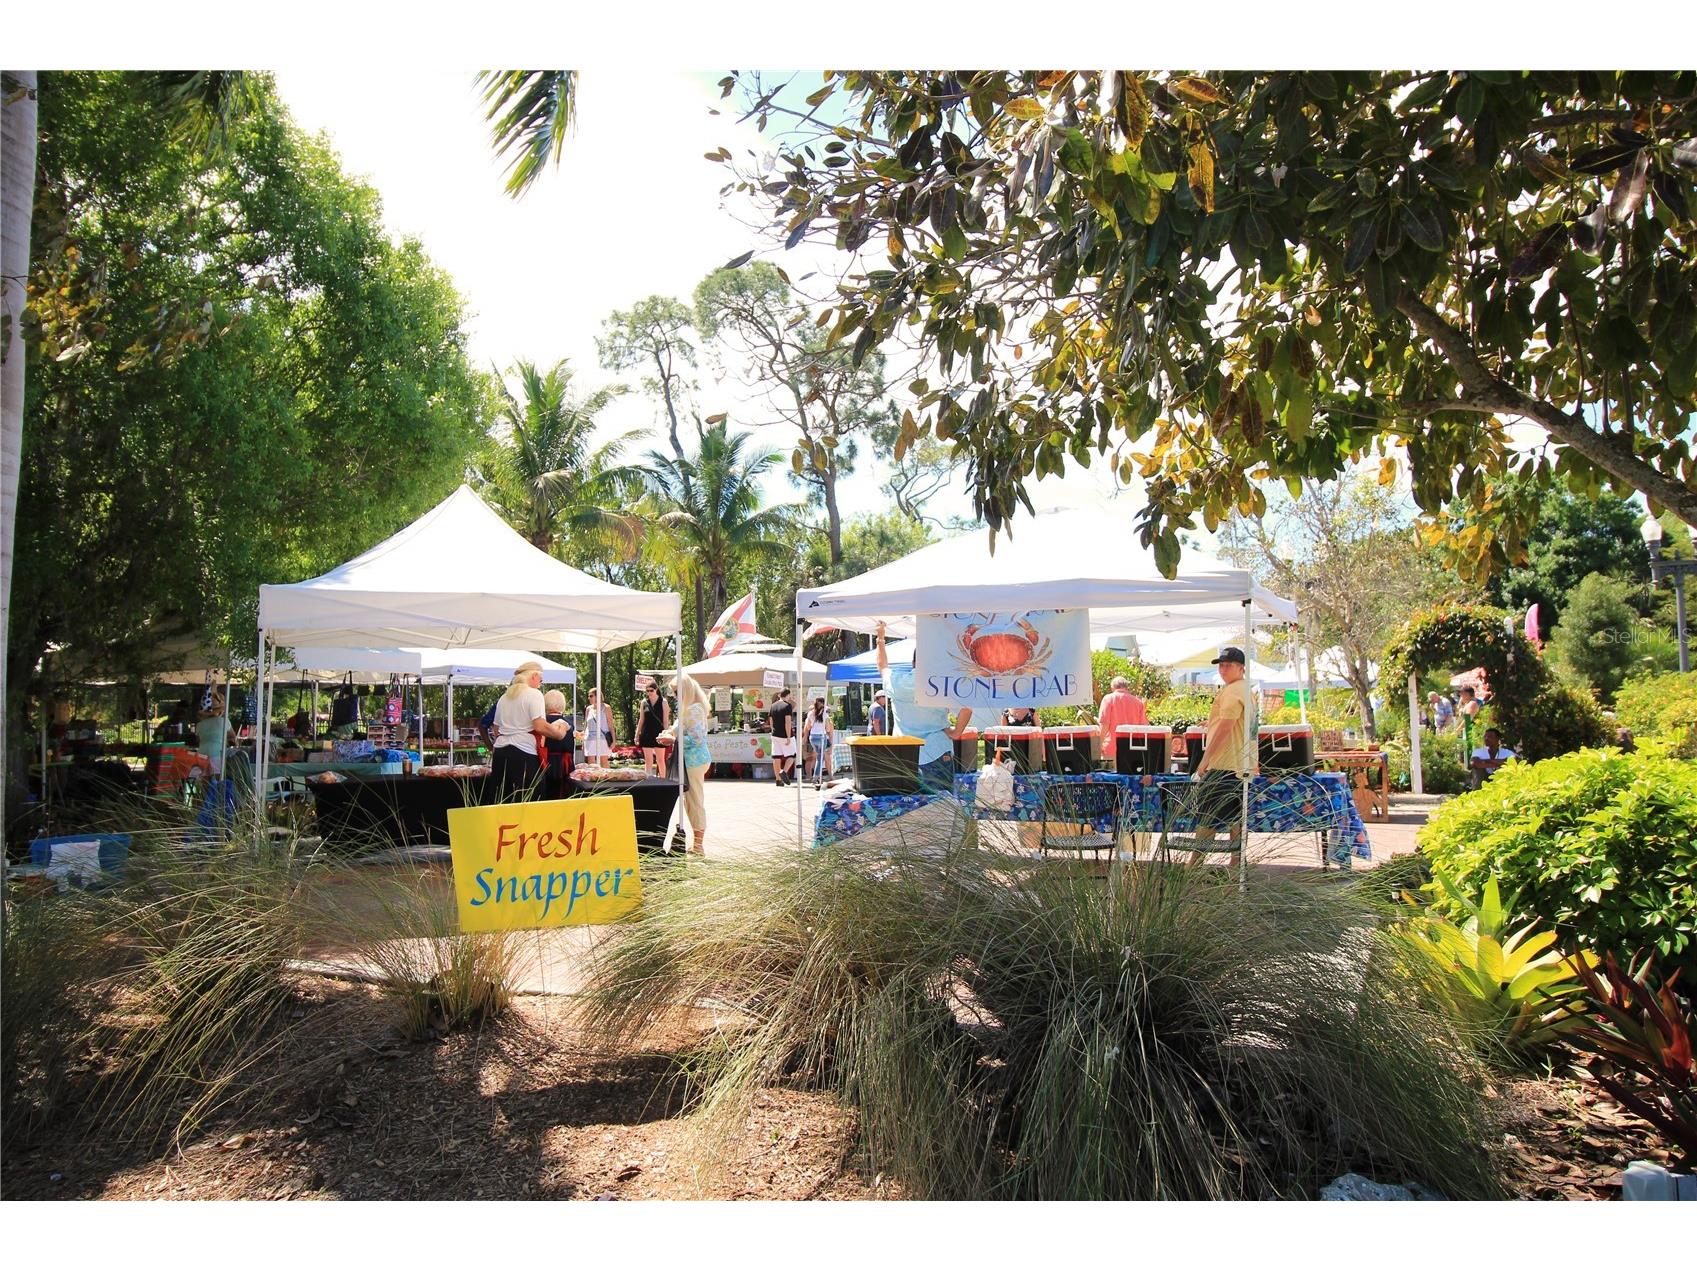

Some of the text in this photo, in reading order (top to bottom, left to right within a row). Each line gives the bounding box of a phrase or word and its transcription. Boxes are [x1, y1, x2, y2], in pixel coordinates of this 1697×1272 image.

[925, 674, 1078, 699] STONE CRAB
[496, 812, 600, 862] Fresh
[470, 867, 634, 921] Snapper
